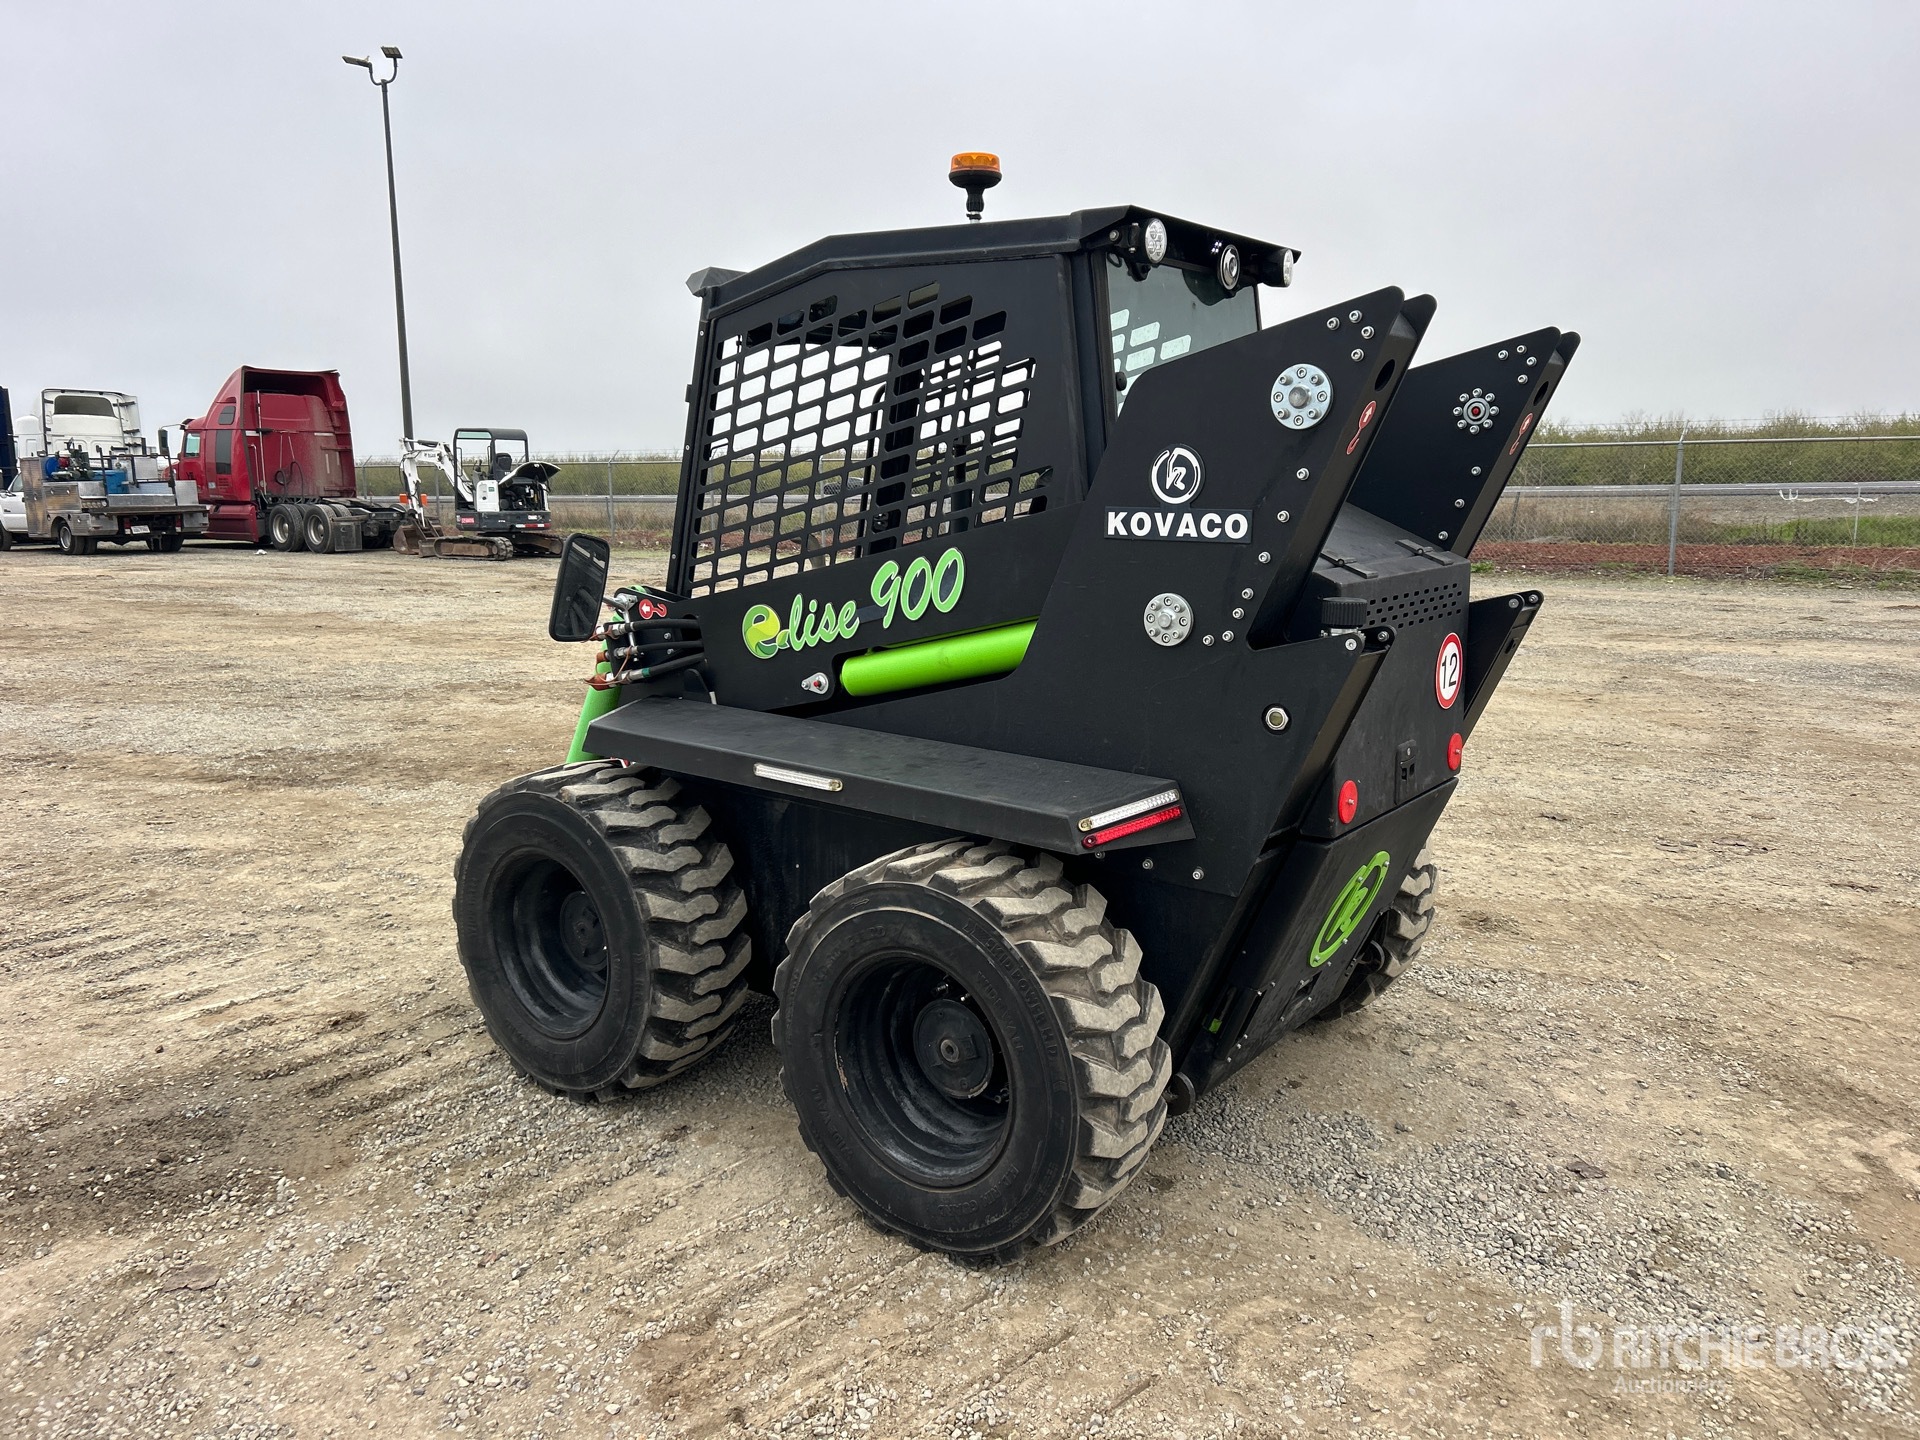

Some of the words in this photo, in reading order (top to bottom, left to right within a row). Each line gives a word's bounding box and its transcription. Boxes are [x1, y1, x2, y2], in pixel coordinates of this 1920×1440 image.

[1107, 511, 1249, 539] KOVACO
[871, 547, 965, 629] 900
[1441, 653, 1458, 689] 12
